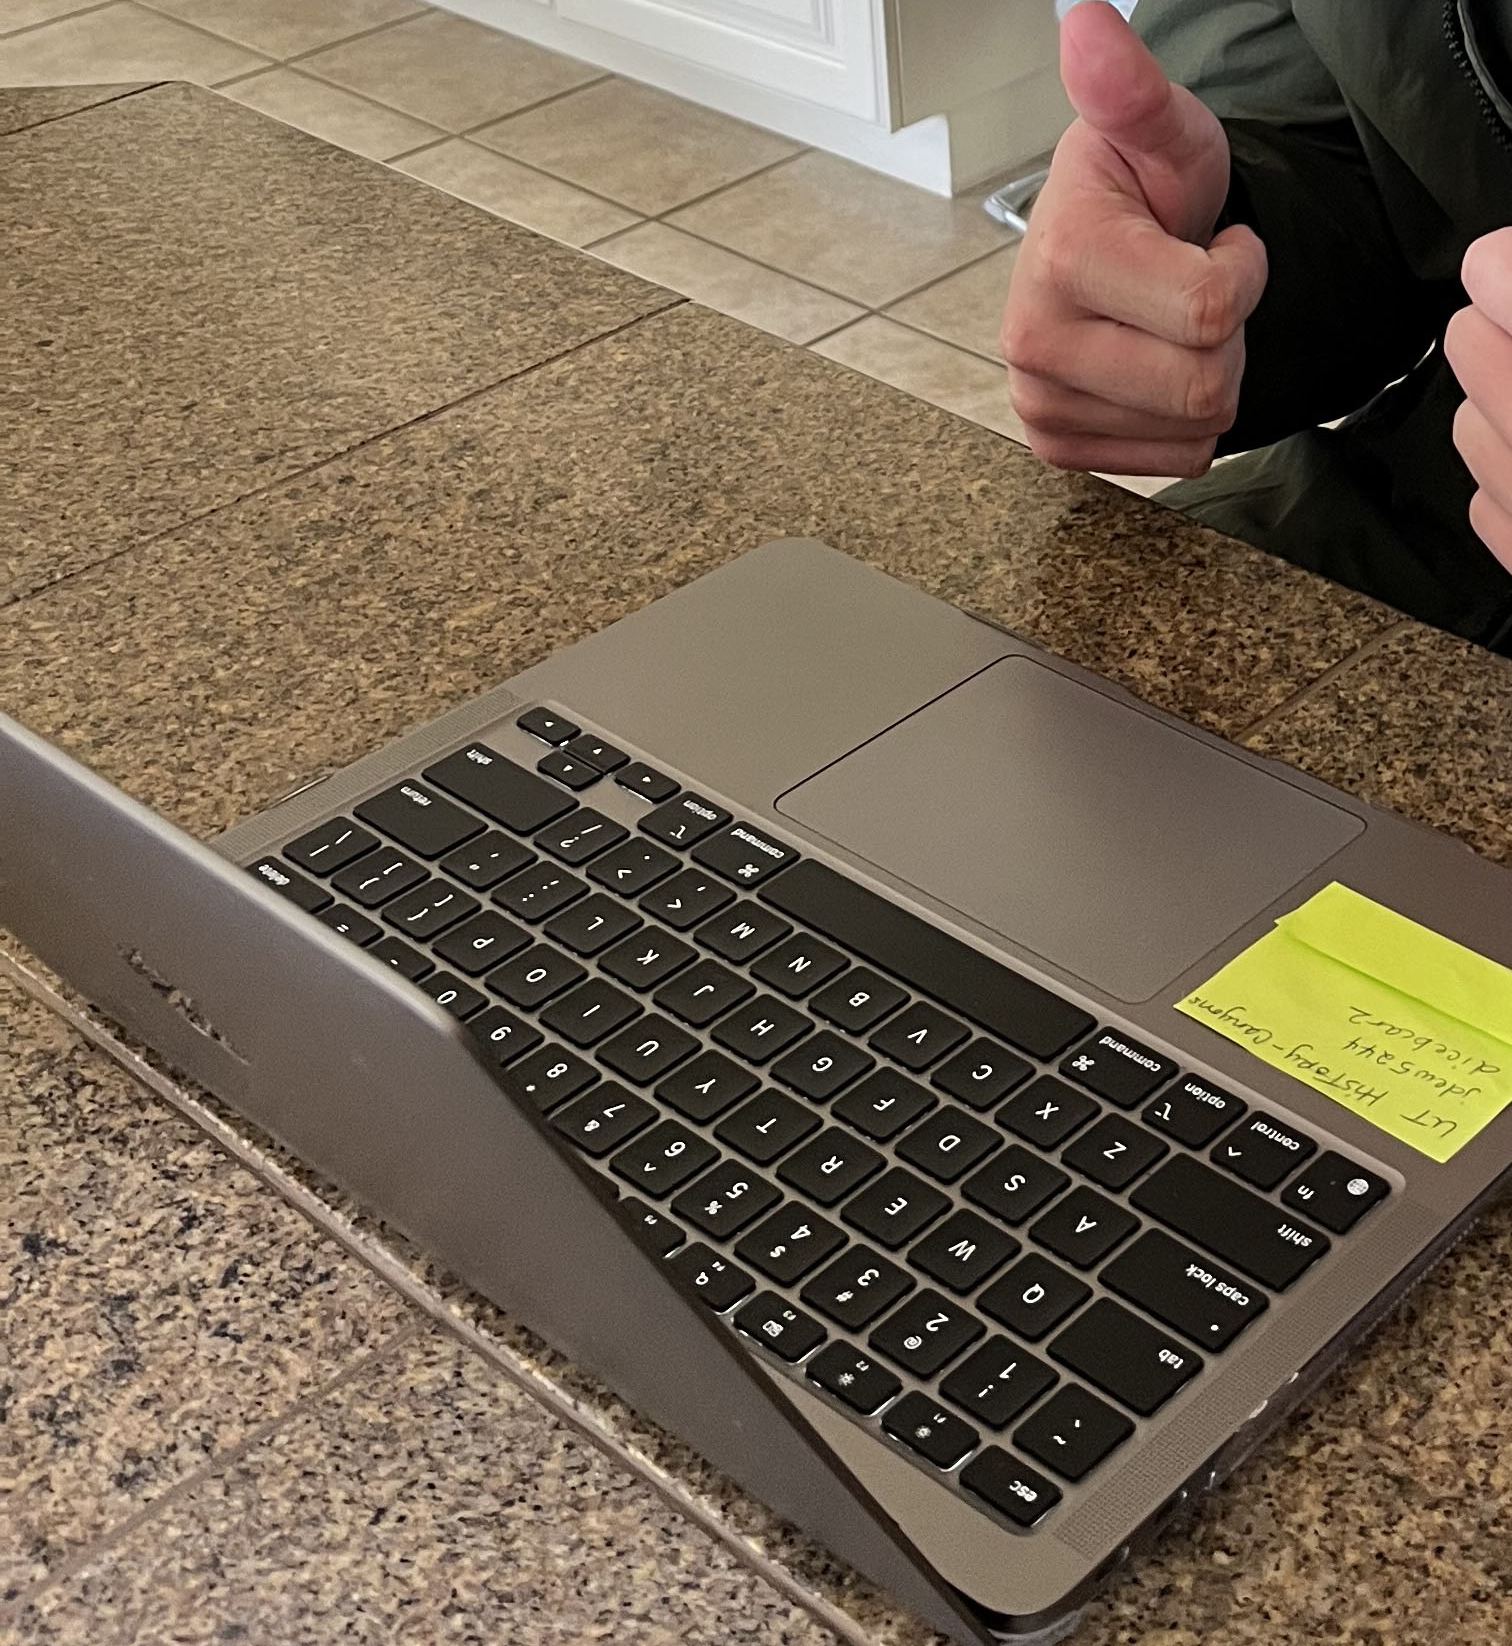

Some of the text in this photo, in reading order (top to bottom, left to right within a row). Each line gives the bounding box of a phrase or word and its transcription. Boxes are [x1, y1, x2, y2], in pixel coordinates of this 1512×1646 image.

[401, 787, 431, 806] return
[683, 800, 717, 820] option
[560, 836, 579, 848] ?
[731, 828, 785, 859] command
[618, 870, 632, 879] >
[667, 899, 681, 908] <
[588, 917, 603, 930] L
[731, 923, 755, 939] M
[473, 938, 494, 949] P
[637, 949, 659, 965] K
[788, 957, 811, 972] N
[526, 969, 546, 982] O
[437, 991, 457, 1004] 0
[693, 985, 714, 996] J
[849, 992, 870, 1007] B
[491, 1027, 511, 1040] 9
[751, 1019, 774, 1036] H
[907, 1029, 927, 1043] V
[636, 1041, 659, 1056] U
[1099, 1036, 1161, 1071] command
[547, 1063, 567, 1078] 8
[812, 1057, 832, 1071] G
[1342, 1036, 1482, 1103] jdew5244
[972, 1065, 992, 1079] C
[695, 1079, 716, 1093] Y
[1185, 1083, 1225, 1108] option
[603, 1104, 625, 1117] 7
[873, 1099, 895, 1111] F
[1035, 1102, 1059, 1119] X
[756, 1118, 776, 1133] T
[1400, 1109, 1458, 1137] UT
[939, 1135, 960, 1151] D
[1251, 1122, 1299, 1150] control
[665, 1142, 685, 1157] 6
[1103, 1142, 1126, 1159] Z
[821, 1156, 843, 1173] R
[726, 1183, 748, 1198] 5
[1004, 1175, 1025, 1191] S
[1298, 1185, 1314, 1199] fn
[705, 1201, 722, 1214] %
[885, 1198, 907, 1215] E
[1076, 1216, 1097, 1232] A
[791, 1225, 811, 1239] 4
[1278, 1224, 1312, 1246] shift
[770, 1246, 785, 1257] $
[948, 1240, 976, 1261] W
[858, 1269, 879, 1286] 3
[1186, 1263, 1250, 1305] caps lock
[836, 1291, 853, 1302] #
[1023, 1284, 1044, 1303] Q
[926, 1313, 949, 1331] 2
[904, 1336, 922, 1349] @
[1159, 1349, 1183, 1369] tab
[999, 1363, 1016, 1378] 1
[1009, 1481, 1037, 1501] esc
